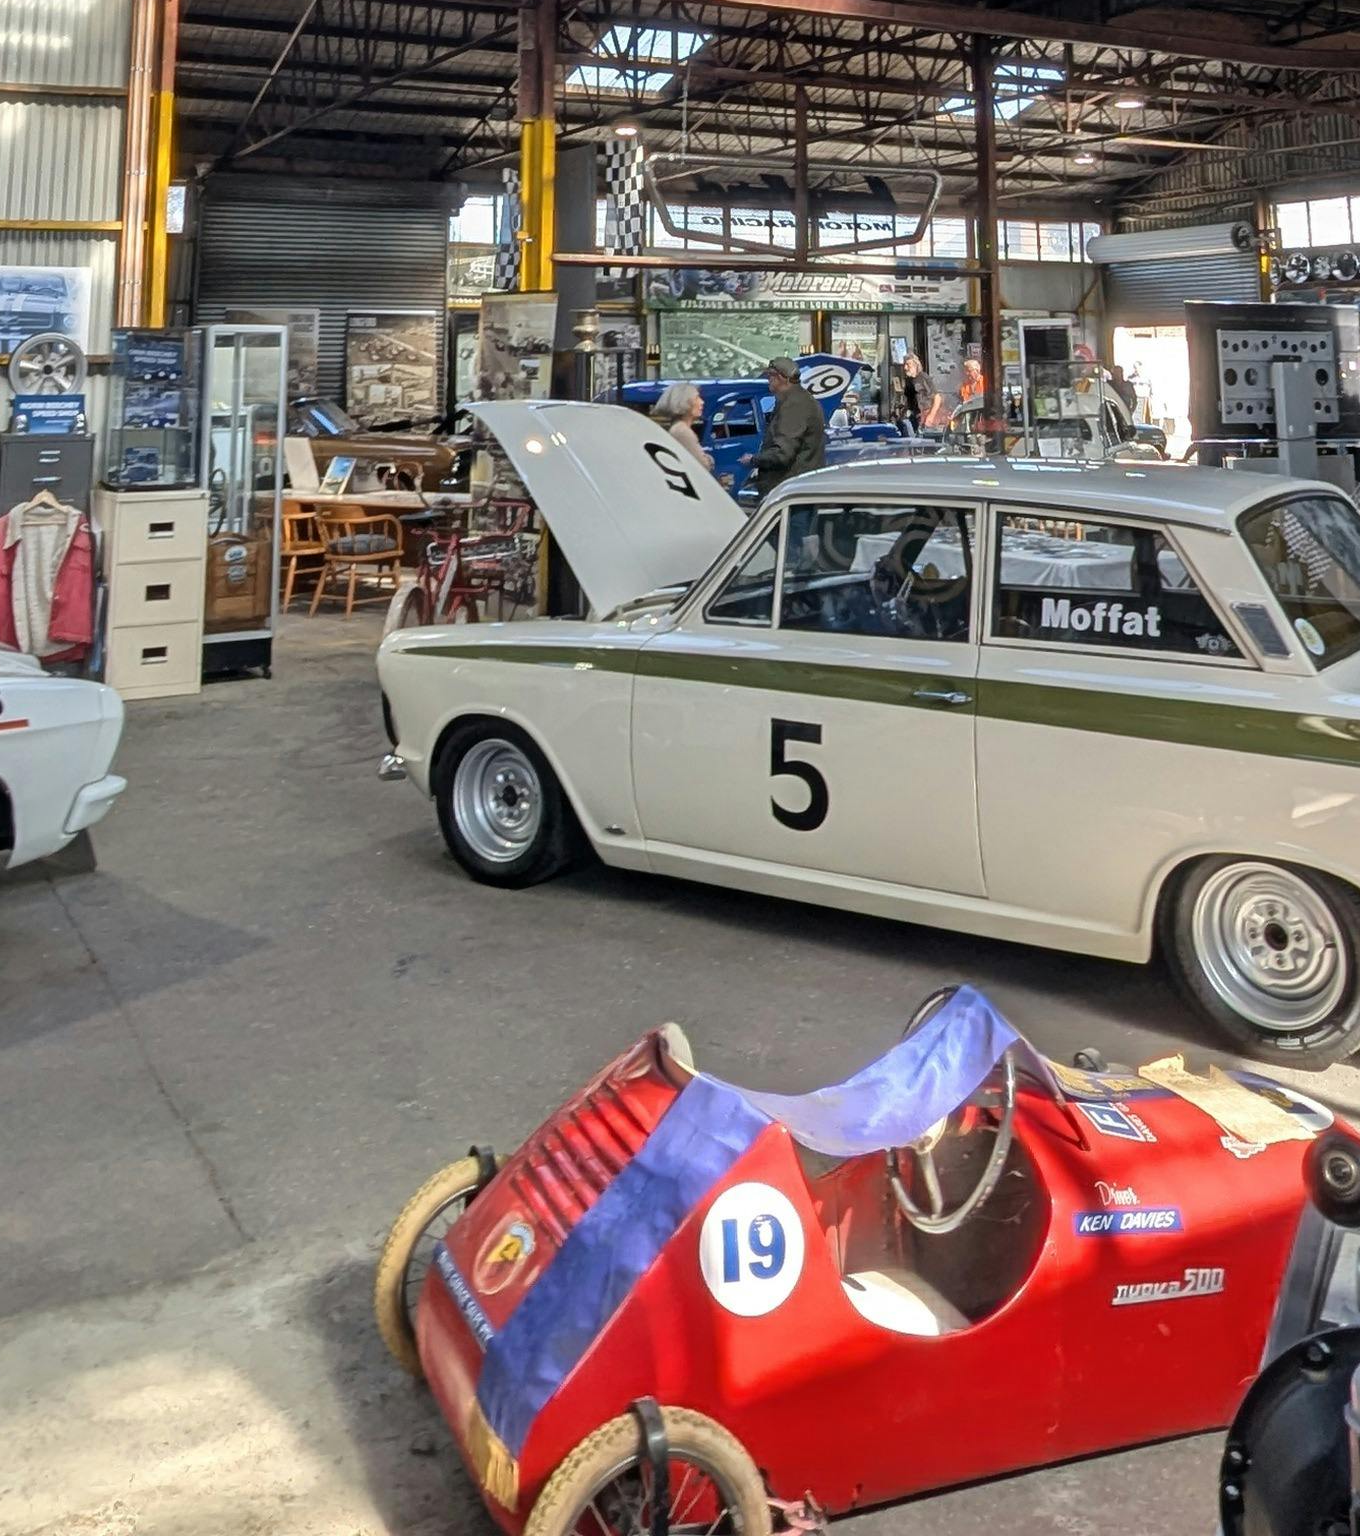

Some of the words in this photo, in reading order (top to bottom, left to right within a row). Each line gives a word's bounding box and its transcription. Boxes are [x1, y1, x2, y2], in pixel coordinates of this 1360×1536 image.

[763, 271, 863, 294] Motorama
[644, 443, 701, 501] 5
[1041, 597, 1162, 637] Moffat
[770, 718, 829, 832] 5
[1079, 1214, 1114, 1232] KEN
[1120, 1211, 1175, 1230] DAVIES
[722, 1214, 787, 1284] 19
[1183, 1267, 1225, 1293] 500
